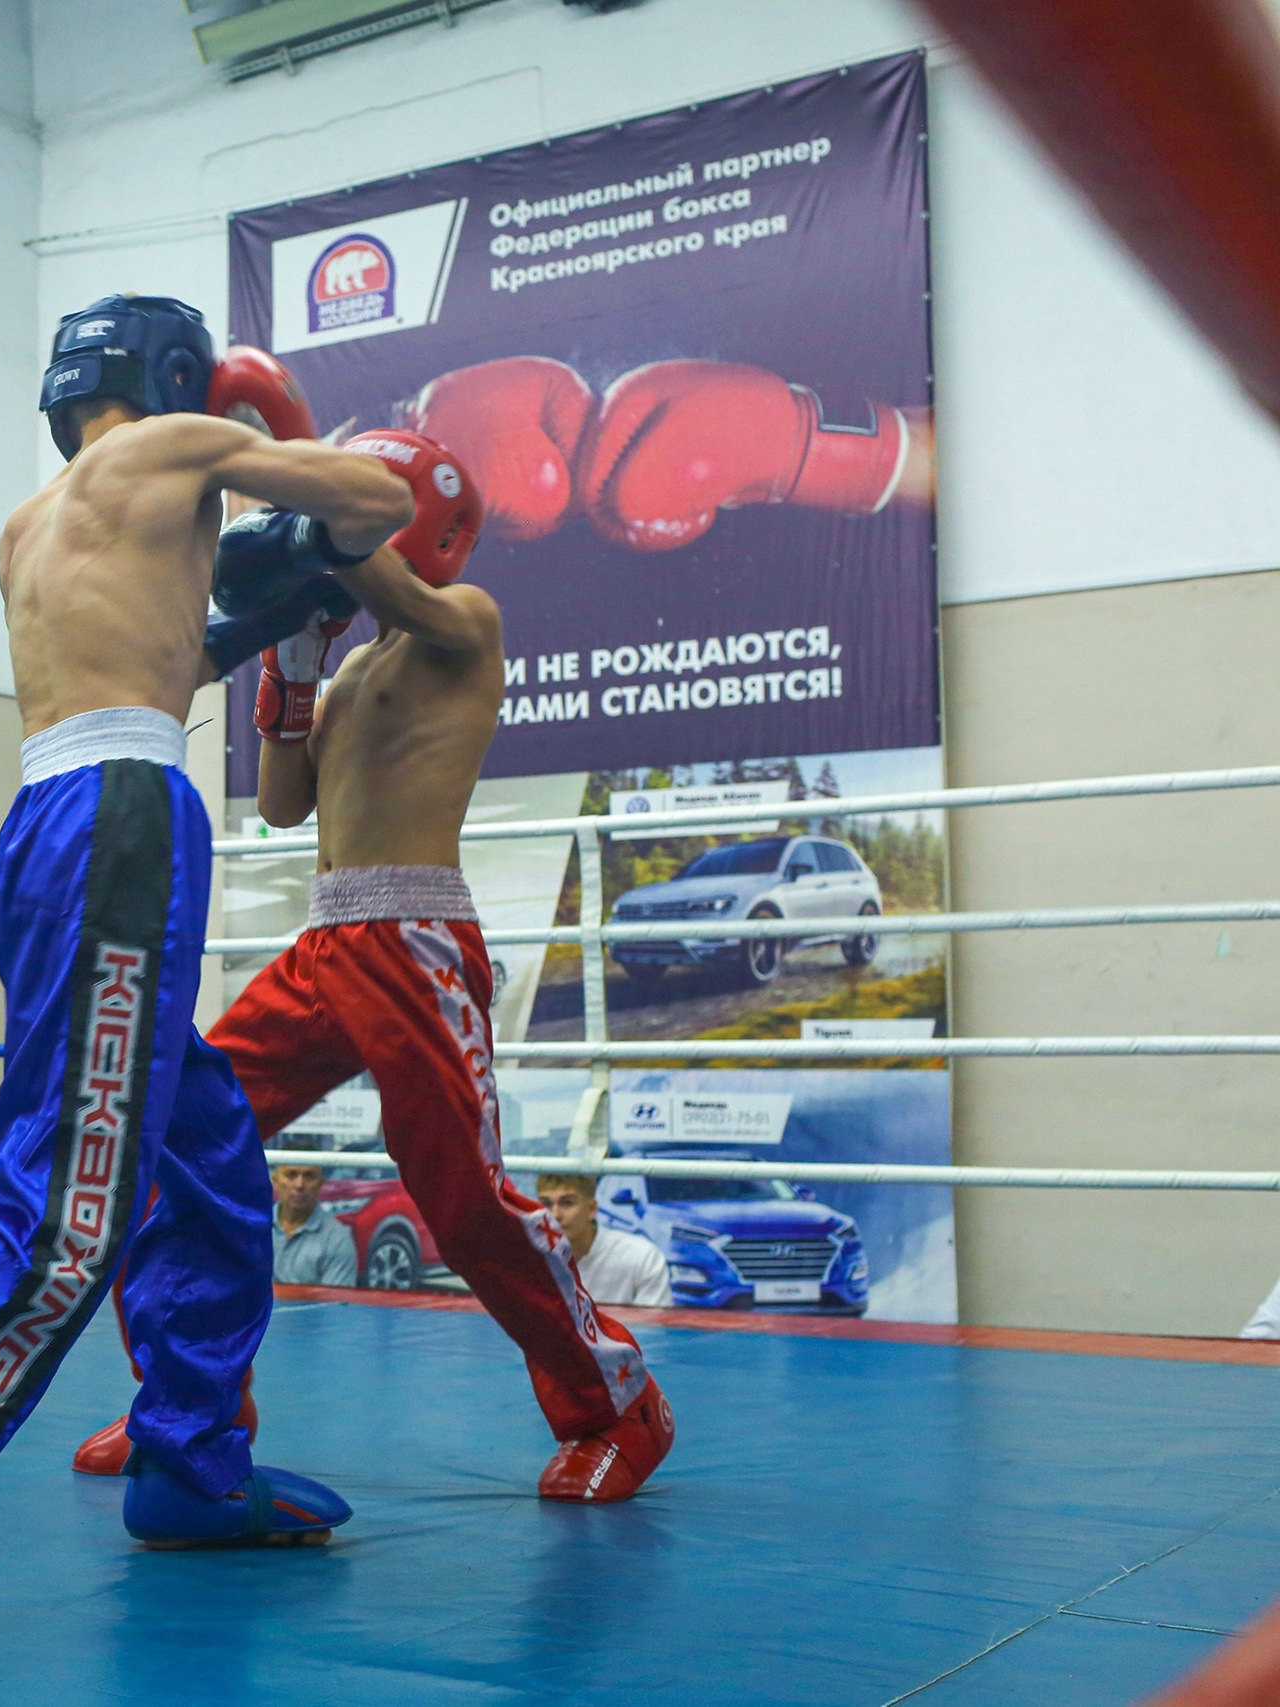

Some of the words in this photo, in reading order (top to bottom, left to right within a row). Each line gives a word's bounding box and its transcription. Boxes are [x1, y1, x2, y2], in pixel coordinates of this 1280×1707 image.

[489, 162, 694, 228] Официальный
[703, 137, 832, 181] партнер
[489, 209, 654, 258] Федерации
[662, 188, 751, 223] бокса
[490, 232, 705, 293] Красноярского
[713, 214, 788, 249] края
[537, 651, 580, 684] НЕ
[590, 625, 843, 679] РОЖДАЮТСЯ,
[601, 666, 843, 717] СТАНОВЯТСЯ!
